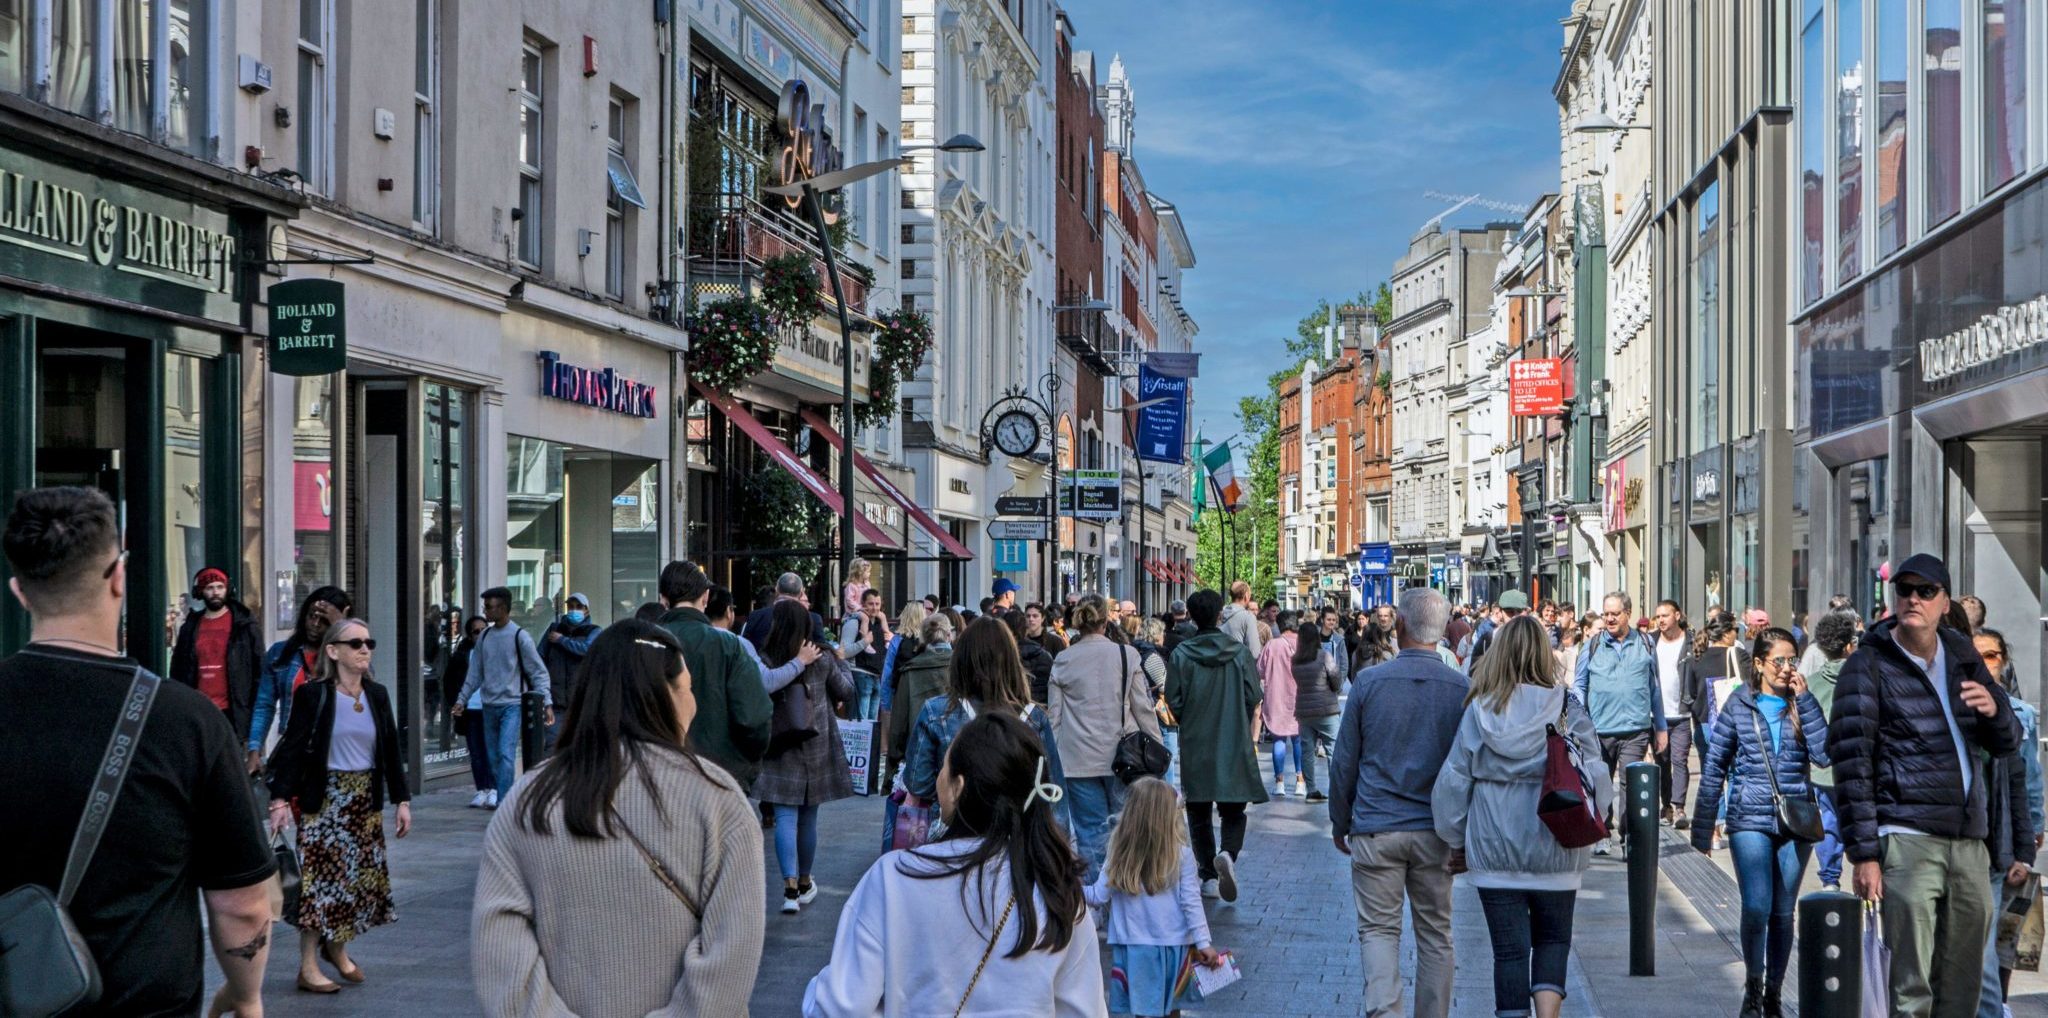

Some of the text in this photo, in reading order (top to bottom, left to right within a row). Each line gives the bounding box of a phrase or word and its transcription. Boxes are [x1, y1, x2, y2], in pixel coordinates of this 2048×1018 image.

[93, 198, 118, 266] &
[124, 206, 235, 294] BARRETT
[277, 303, 336, 320] HOLLAND
[301, 318, 313, 333] &
[279, 334, 336, 351] BARRETT
[1530, 361, 1554, 371] Knight
[1530, 370, 1551, 378] Frank
[540, 350, 657, 419] THOMAS PATRICK
[1525, 387, 1537, 395] LET
[1001, 540, 1020, 564] H
[127, 684, 150, 722] BOSS
[106, 734, 131, 777] BOSS
